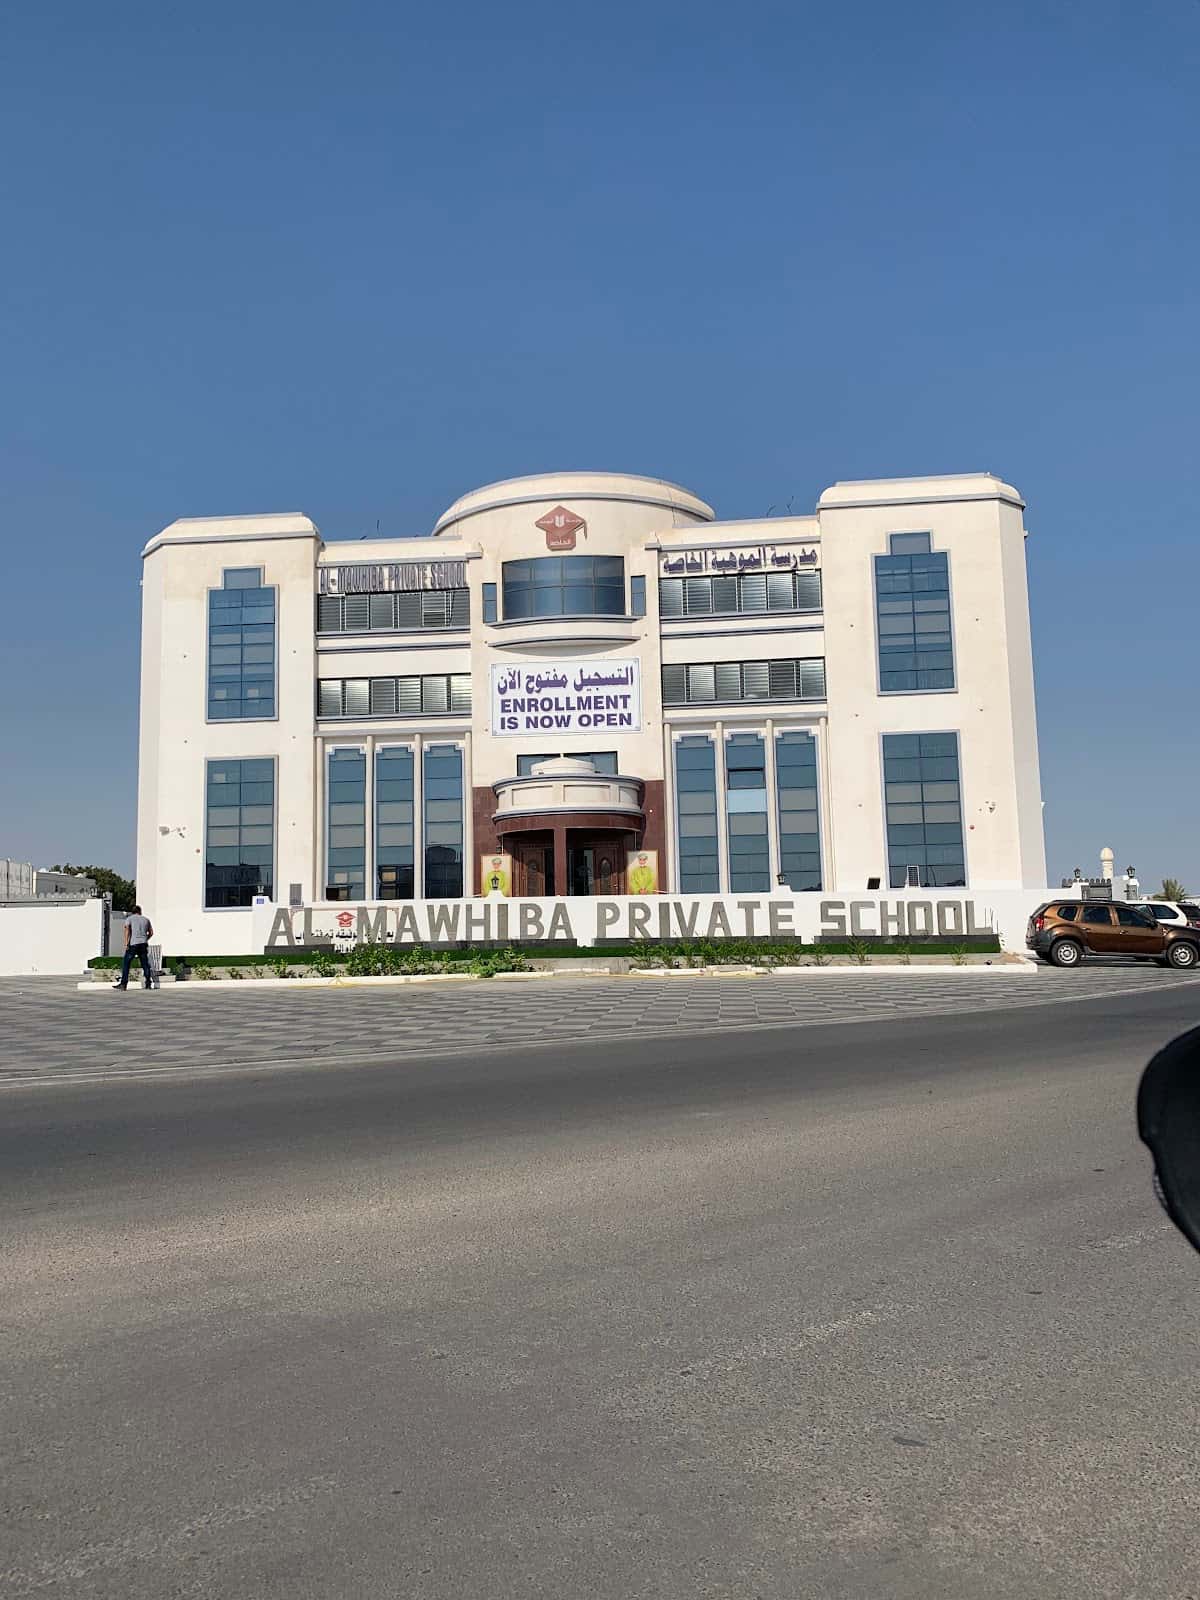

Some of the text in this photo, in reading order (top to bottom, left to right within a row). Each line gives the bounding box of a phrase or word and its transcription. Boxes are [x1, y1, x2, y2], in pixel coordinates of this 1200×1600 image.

[660, 548, 708, 574] الخاصة
[771, 544, 818, 570] مدرسة
[388, 563, 428, 591] PRIVATE
[431, 561, 468, 589] SCHOOL
[525, 668, 568, 694] مفتوح
[573, 665, 634, 692] التسجيل
[500, 694, 631, 713] ENROLLMENT
[500, 712, 632, 729] IS NOW OPEN
[267, 900, 993, 946] AL MAWHIBA PRIVATE SCHOOL
